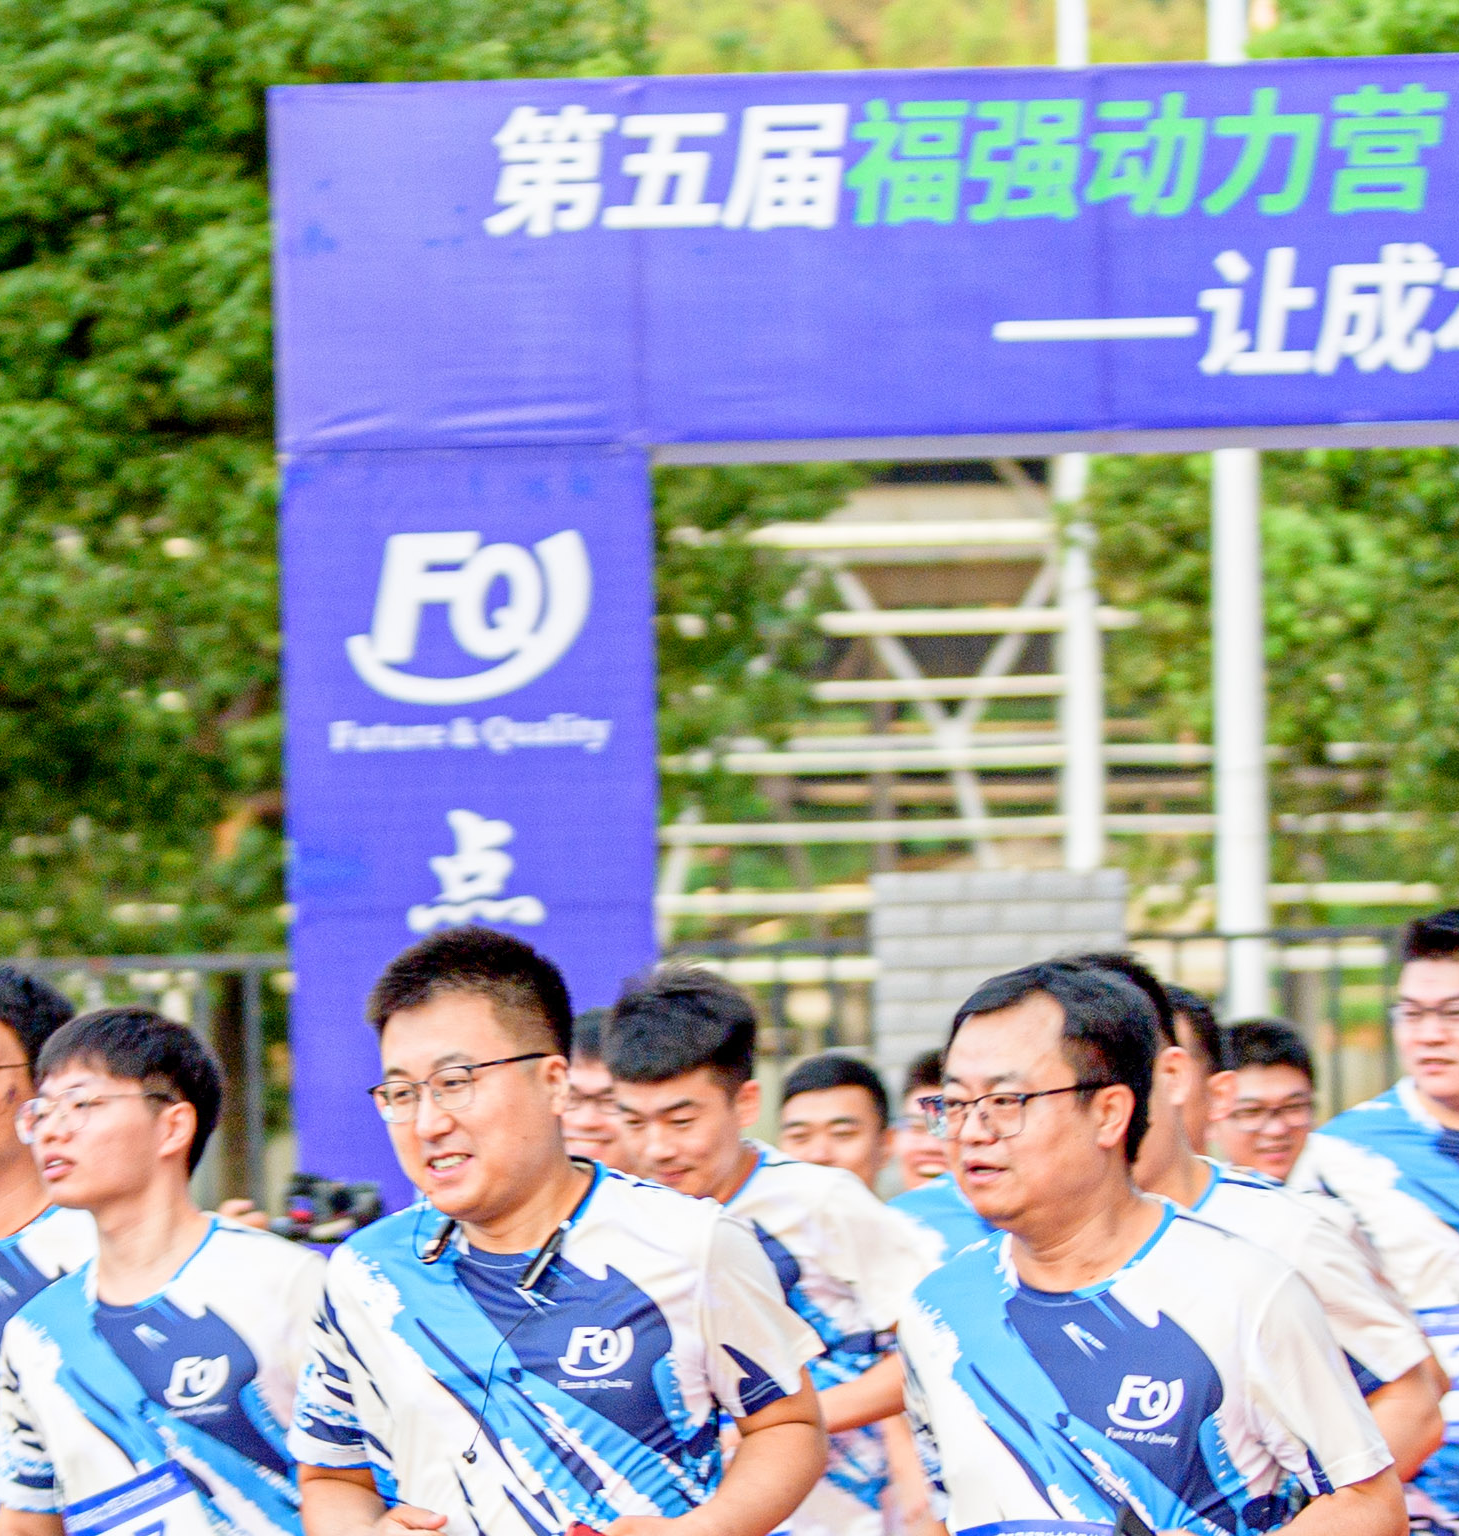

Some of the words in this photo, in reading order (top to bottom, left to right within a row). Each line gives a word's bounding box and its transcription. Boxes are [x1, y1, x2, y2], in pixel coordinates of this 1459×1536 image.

[329, 720, 445, 752] Future
[446, 717, 478, 750] &
[480, 713, 613, 754] Quality
